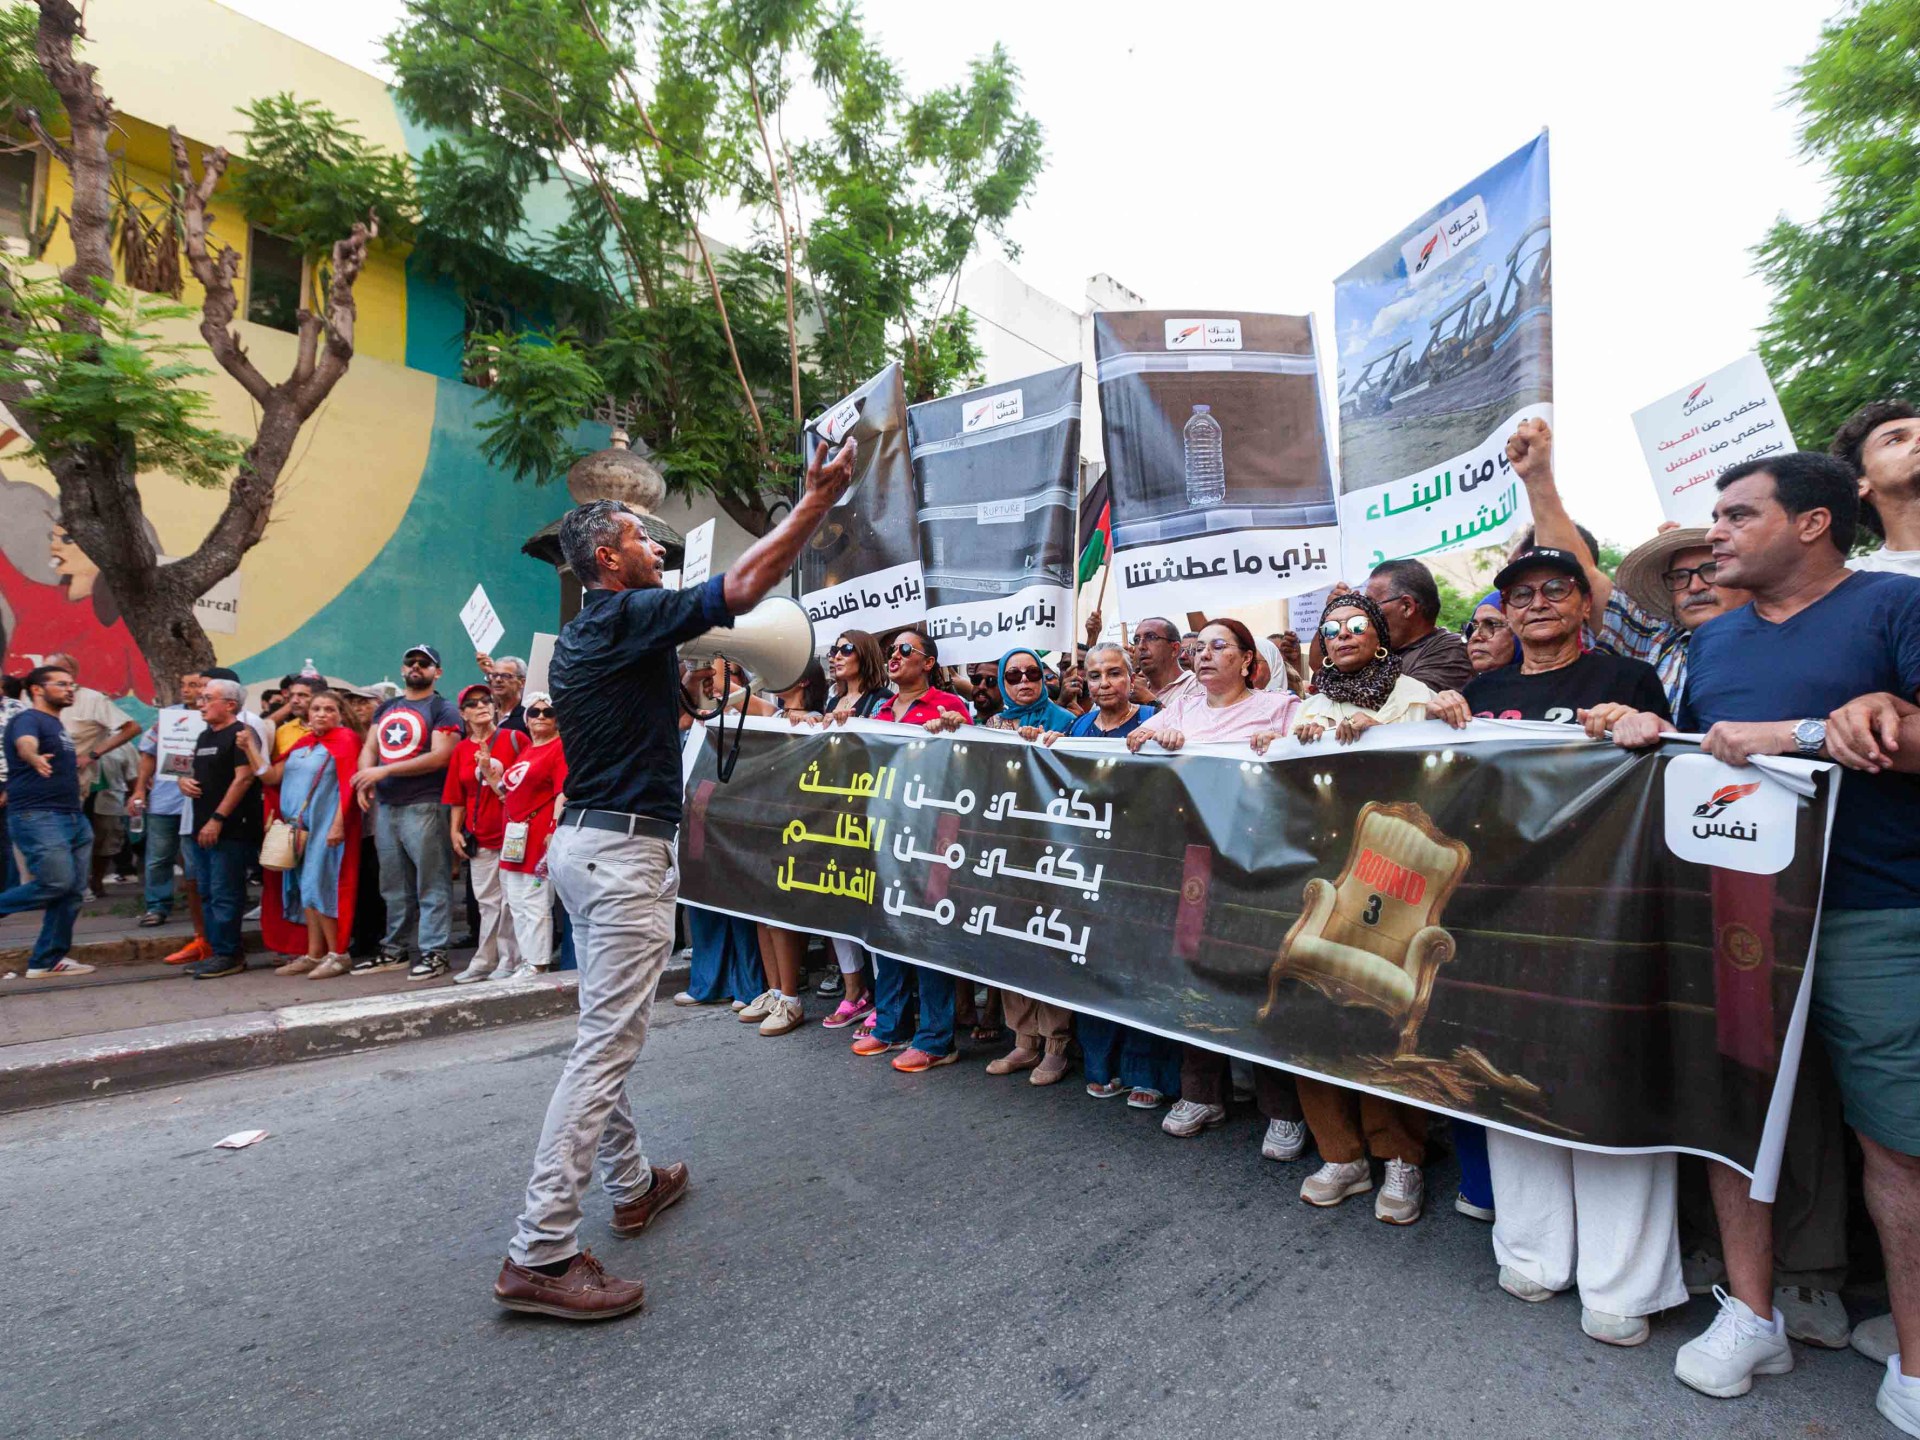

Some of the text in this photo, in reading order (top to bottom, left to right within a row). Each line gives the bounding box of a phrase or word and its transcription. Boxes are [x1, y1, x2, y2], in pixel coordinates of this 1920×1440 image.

[1453, 221, 1480, 247] نفس
[1209, 336, 1236, 344] نفس
[997, 408, 1018, 420] نفس
[1657, 397, 1767, 451] يكفي من العبث
[1683, 395, 1715, 418] نفس
[1664, 419, 1776, 474] يكفي من الفشل
[1459, 458, 1495, 493] من
[1672, 469, 1716, 496] الظلم
[983, 503, 1021, 517] RUPTURE
[1366, 471, 1452, 521] البناء
[1124, 542, 1328, 589] يزي ما عطشتنا
[195, 598, 238, 614] arcal
[806, 576, 922, 623] يزي ما ظلمته
[927, 598, 1056, 641] يزي ما مرضتنا
[798, 760, 1114, 841] يكفي من العبث
[1692, 820, 1758, 842] نفس
[782, 812, 1105, 902] يكفي من الظلم
[1353, 848, 1427, 906] ROUND
[776, 855, 1091, 966] يكفي من الفشل
[1362, 893, 1383, 926] 3
